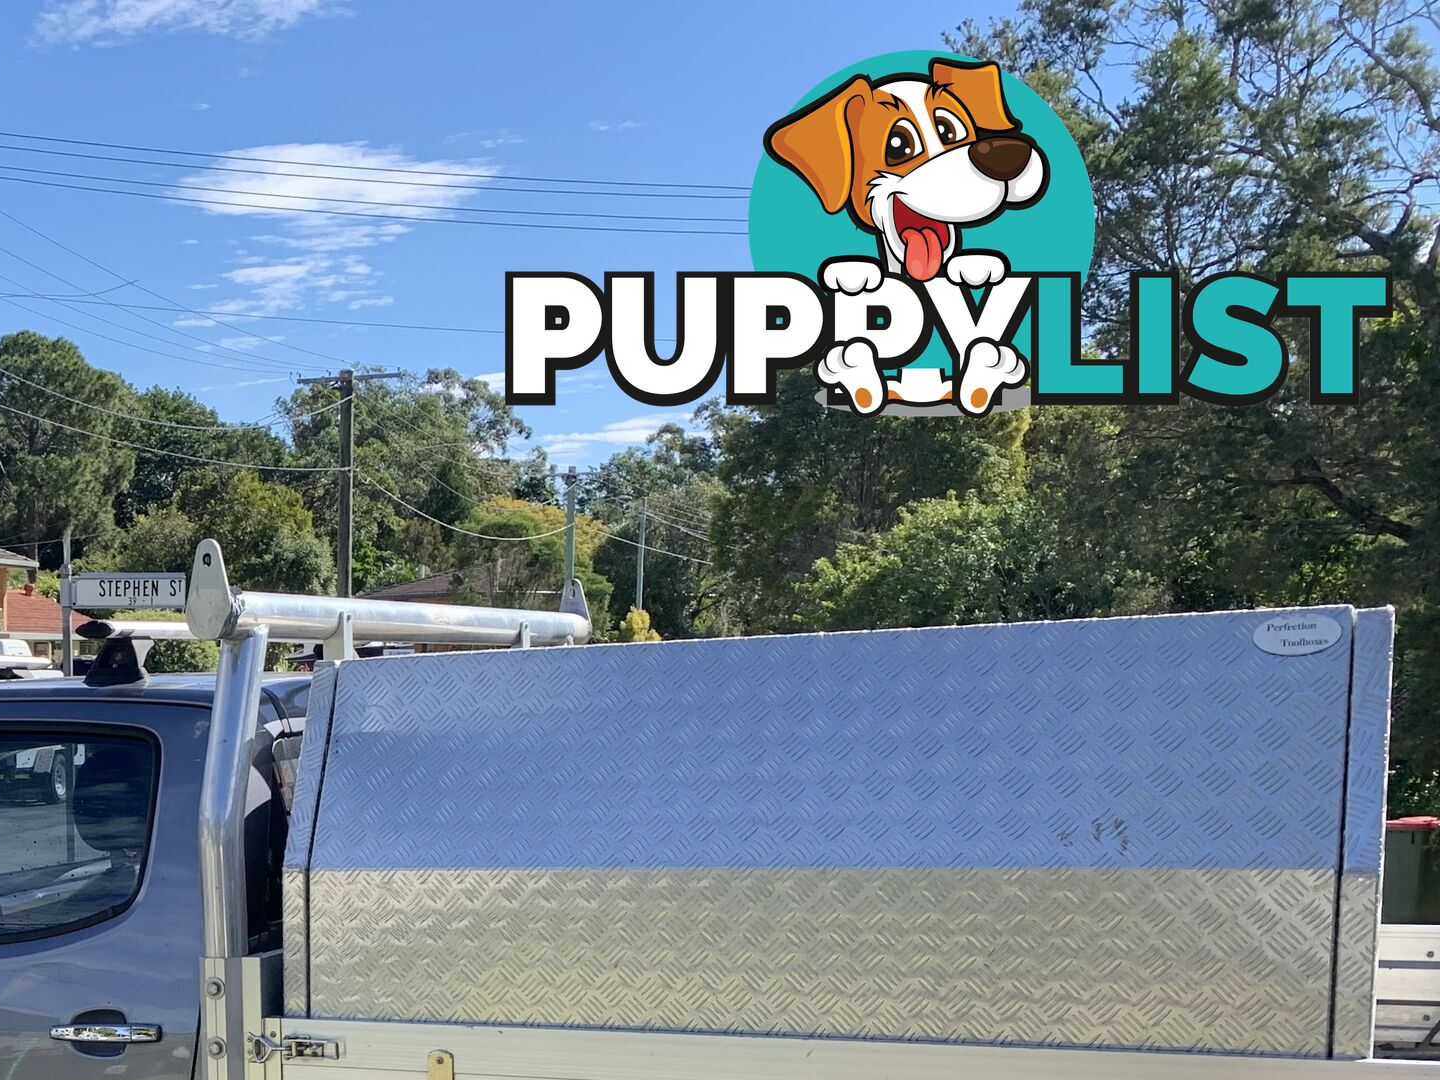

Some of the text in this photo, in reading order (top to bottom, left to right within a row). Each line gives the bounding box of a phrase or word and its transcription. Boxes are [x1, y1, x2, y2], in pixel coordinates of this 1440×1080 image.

[98, 579, 182, 598] STEPHEN ST
[1266, 621, 1317, 632] Perfection
[1280, 637, 1329, 648] Toolboxes
